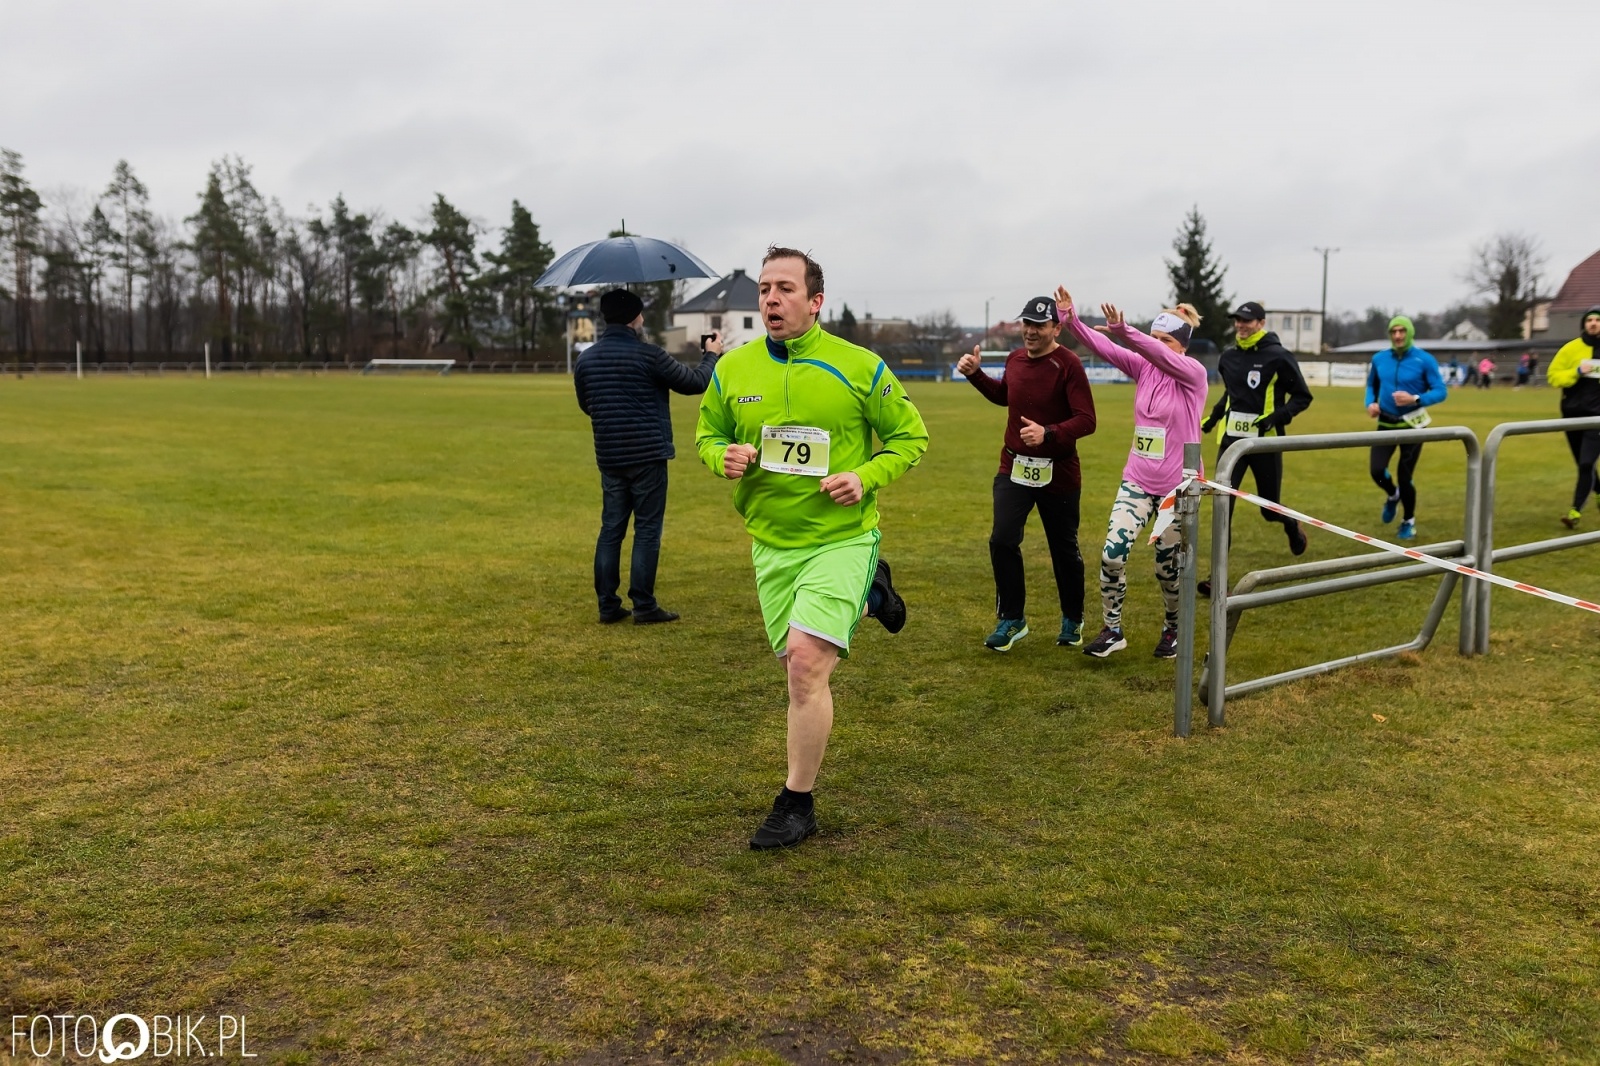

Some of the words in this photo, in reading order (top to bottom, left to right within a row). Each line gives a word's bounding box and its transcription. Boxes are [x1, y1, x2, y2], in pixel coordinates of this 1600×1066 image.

[1235, 421, 1249, 432] 68
[1137, 437, 1153, 451] 57
[782, 441, 811, 464] 79
[1023, 467, 1040, 481] 58
